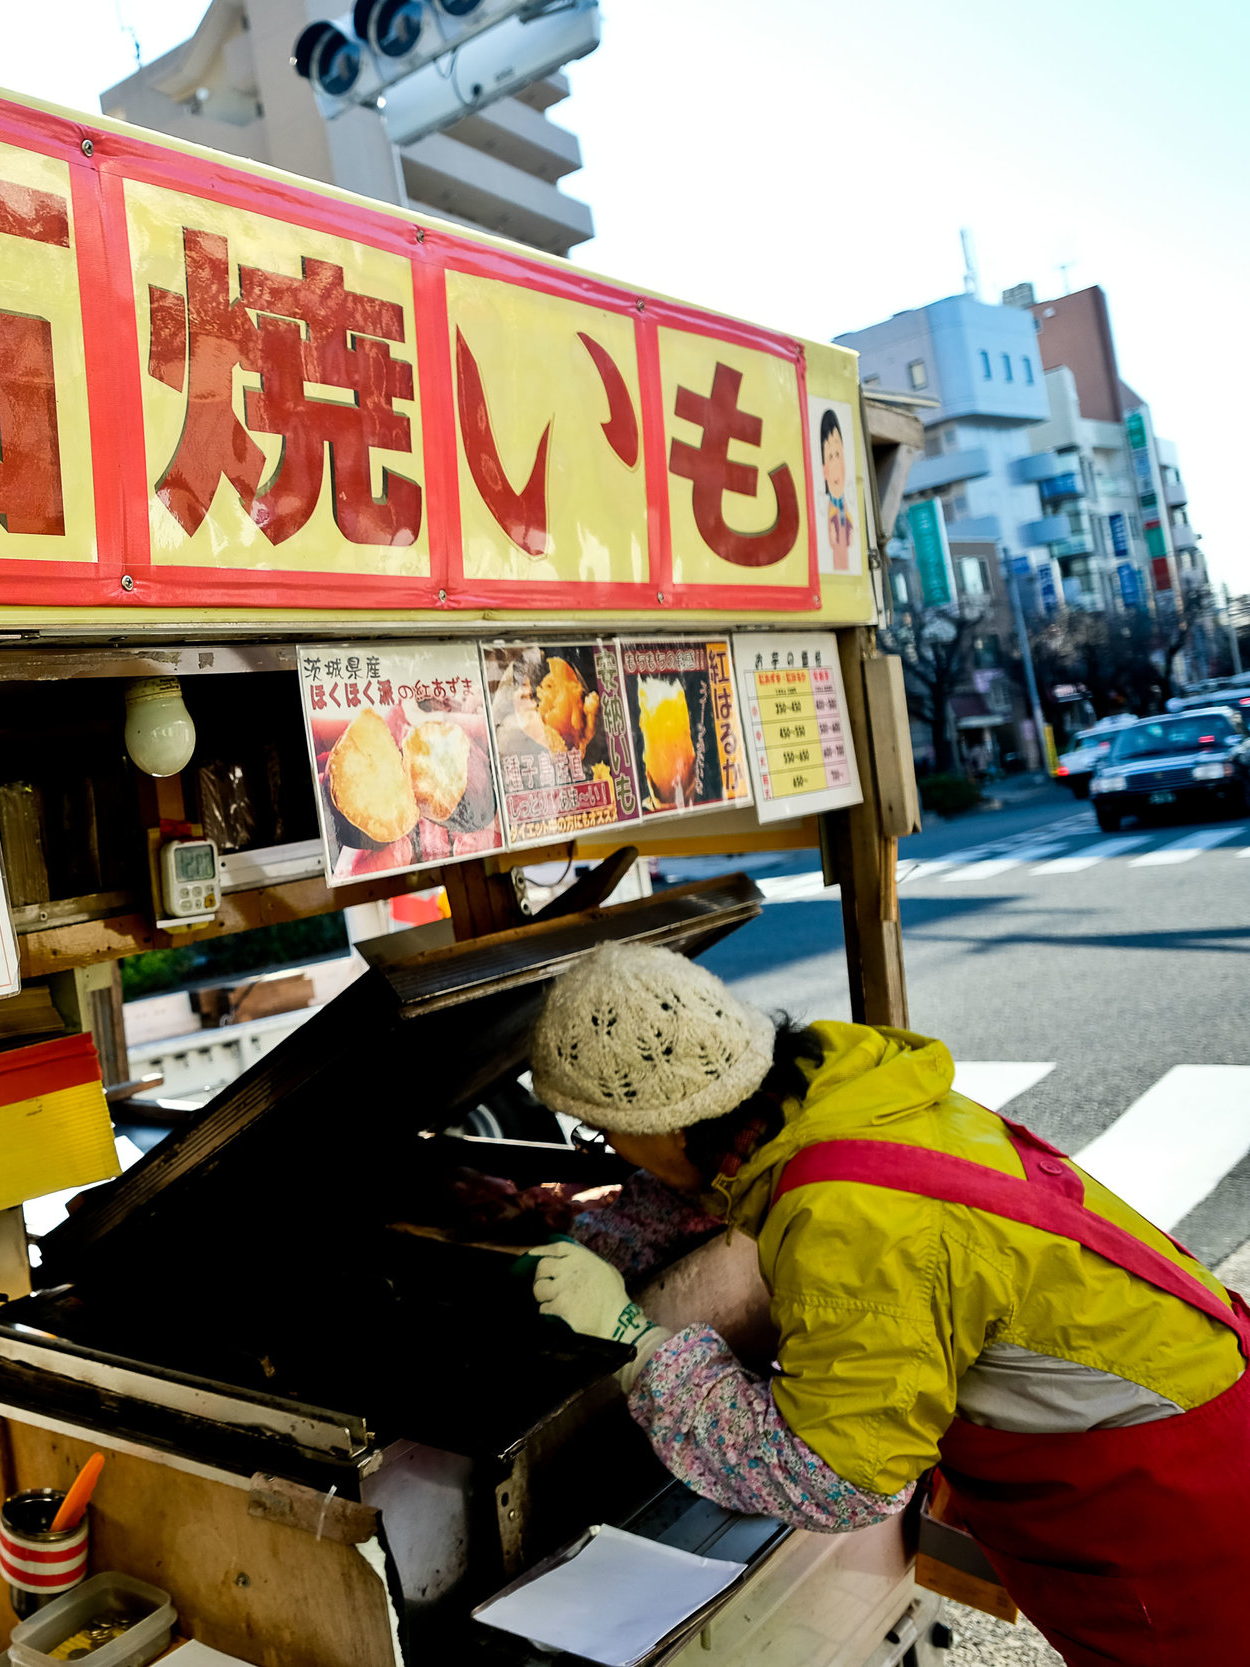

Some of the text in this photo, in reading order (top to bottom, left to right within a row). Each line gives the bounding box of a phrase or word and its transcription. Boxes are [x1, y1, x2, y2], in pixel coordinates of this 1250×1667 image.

[303, 656, 381, 681] 茨城県産
[594, 649, 636, 815] 安納いも
[709, 650, 743, 790] 紅はるか
